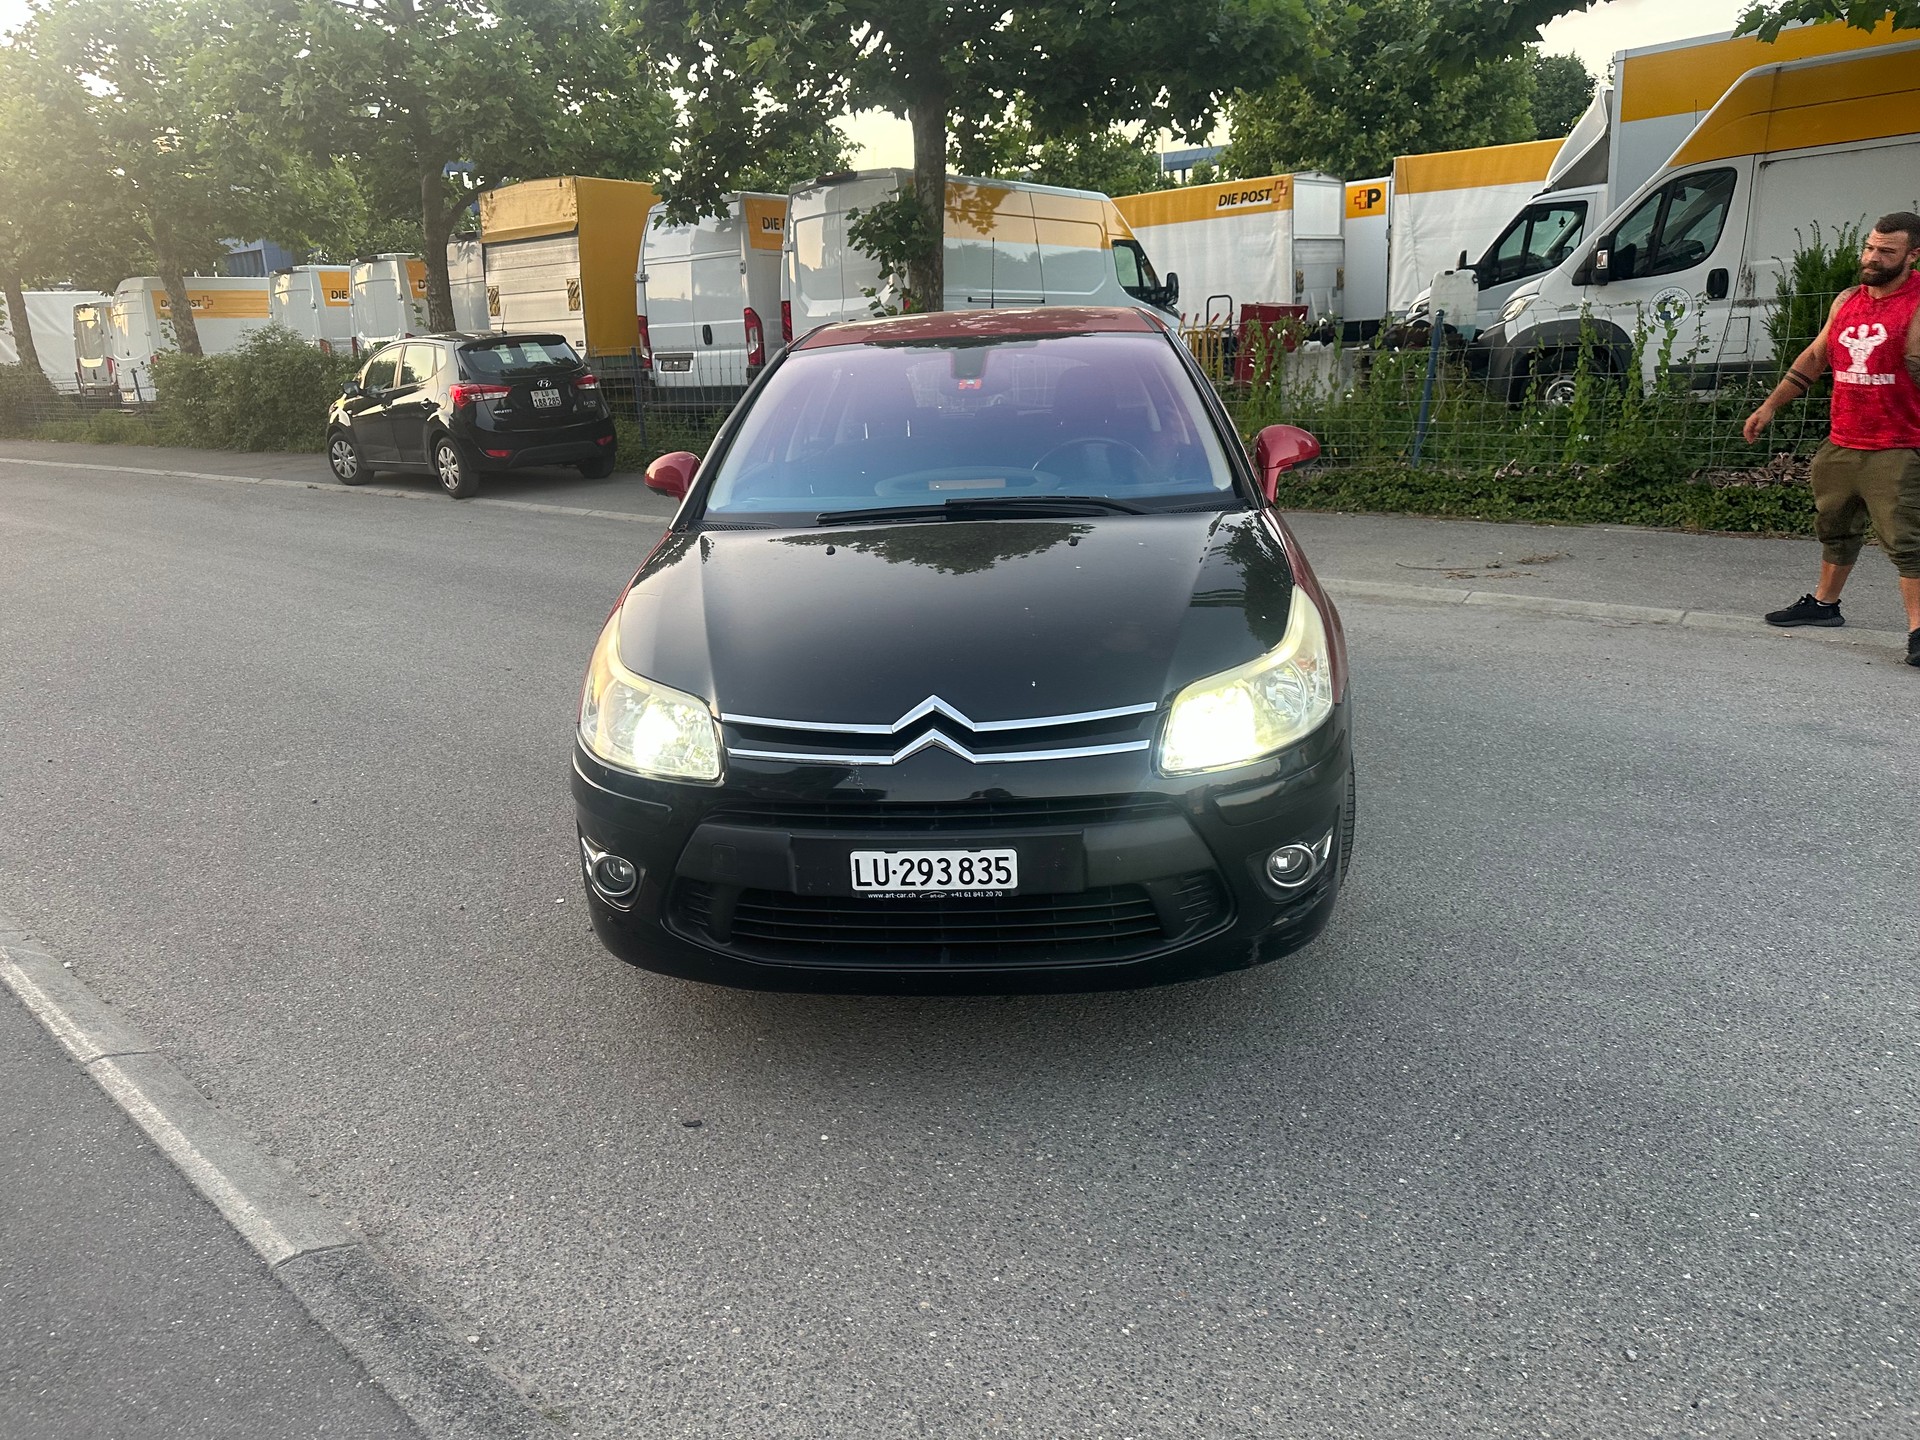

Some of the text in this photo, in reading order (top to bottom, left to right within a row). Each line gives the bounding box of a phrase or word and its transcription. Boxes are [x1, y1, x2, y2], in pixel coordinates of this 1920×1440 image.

[1219, 188, 1272, 207] DIE POST
[762, 217, 780, 231] DIE
[331, 291, 347, 300] DIE
[541, 390, 550, 398] LU
[985, 890, 994, 898] 20
